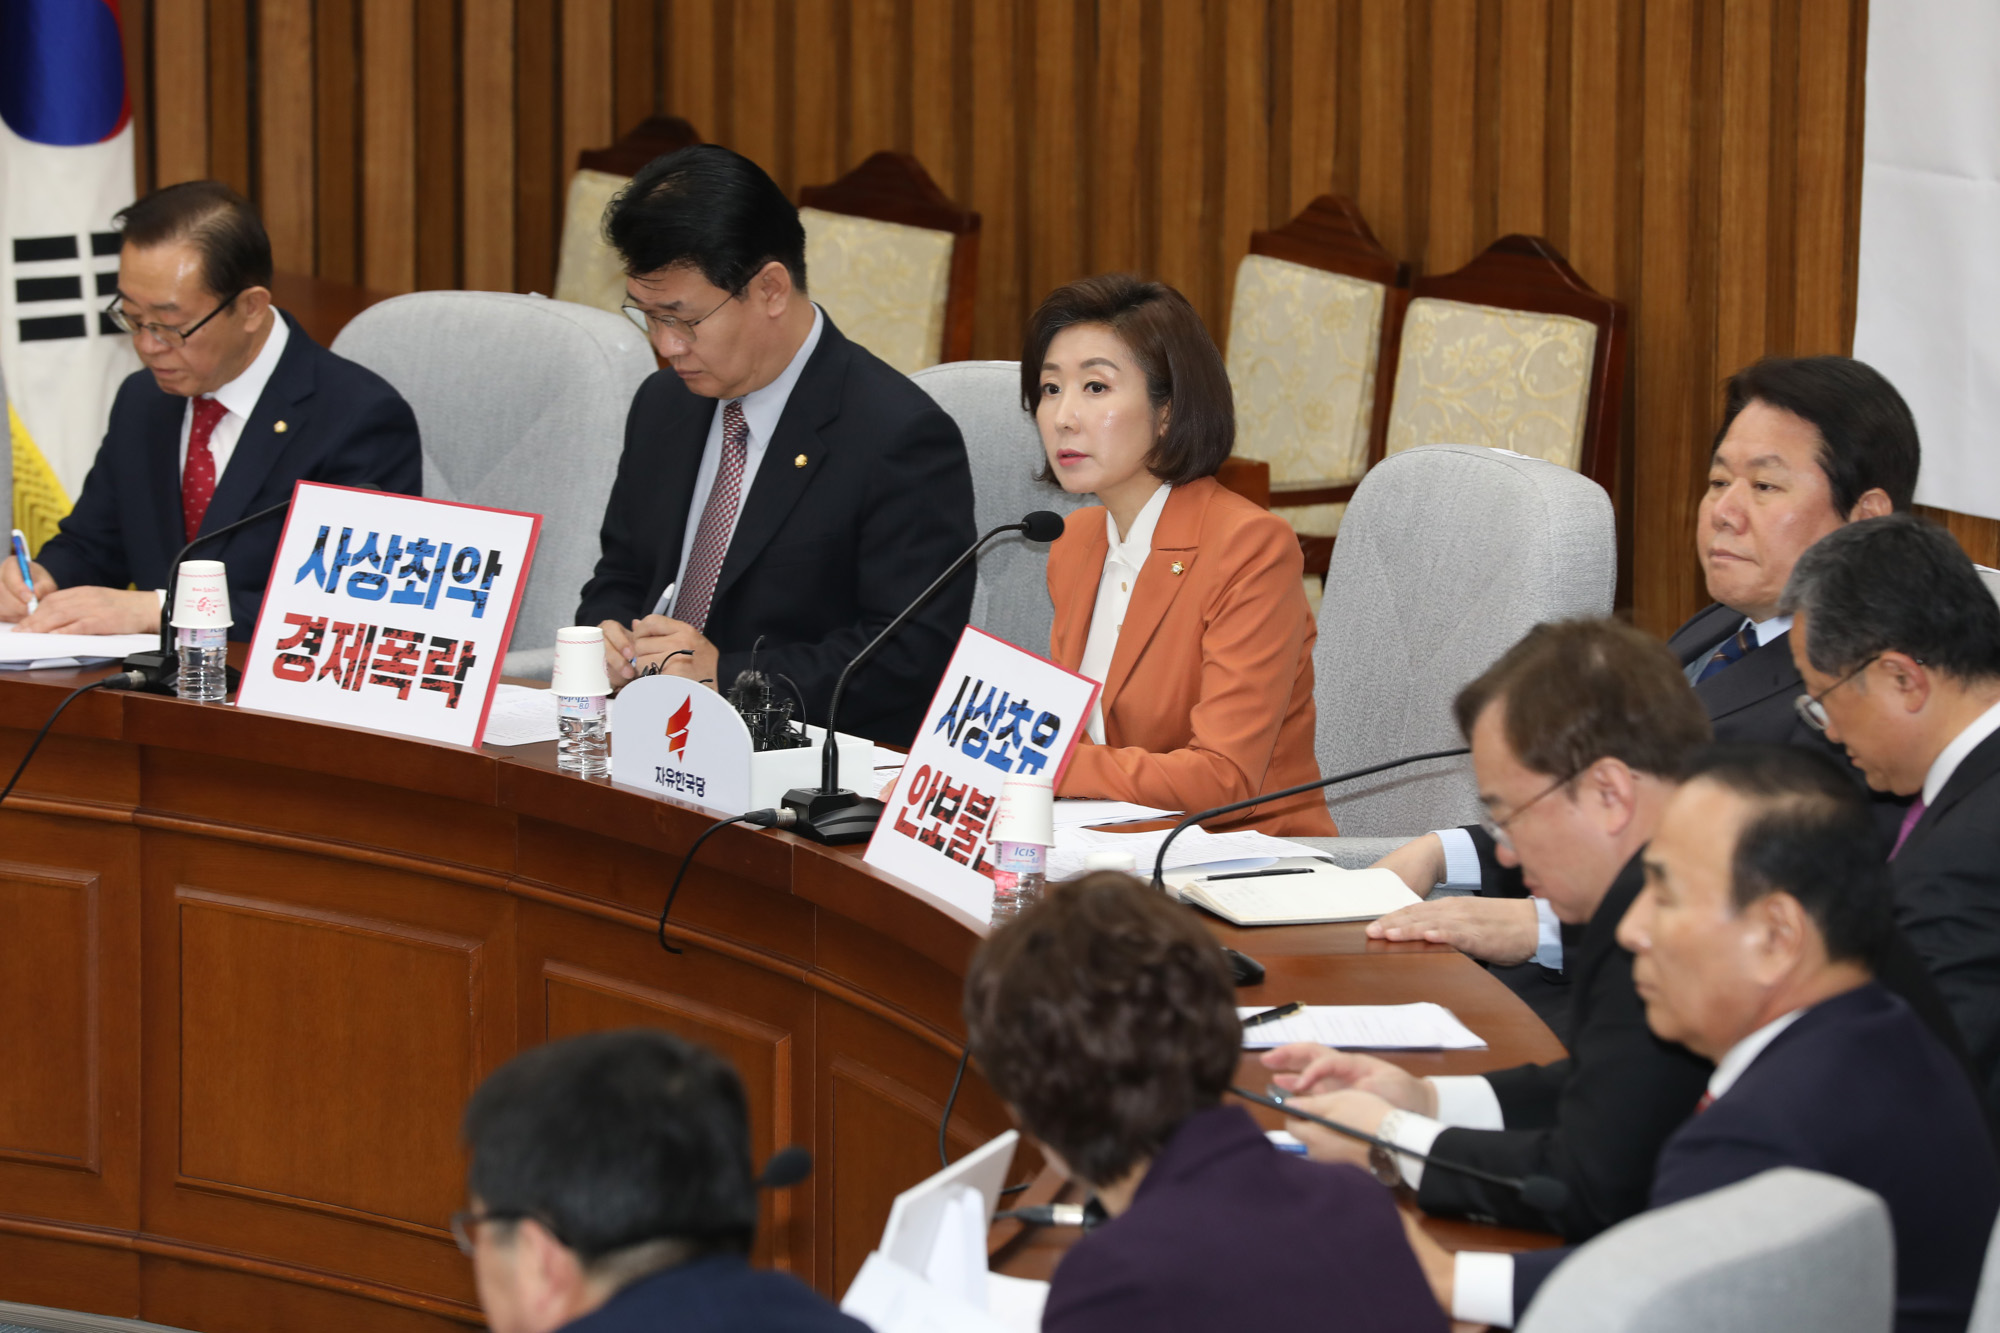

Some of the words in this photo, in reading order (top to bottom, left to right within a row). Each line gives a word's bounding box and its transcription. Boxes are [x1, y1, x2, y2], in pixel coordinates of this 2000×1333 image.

[294, 525, 503, 618] 사상최악
[272, 612, 478, 709] 경제폭락
[578, 702, 590, 710] 8.0
[933, 675, 1061, 776] 사상초유
[655, 766, 706, 797] 자유한국당
[1014, 847, 1036, 857] ICIS
